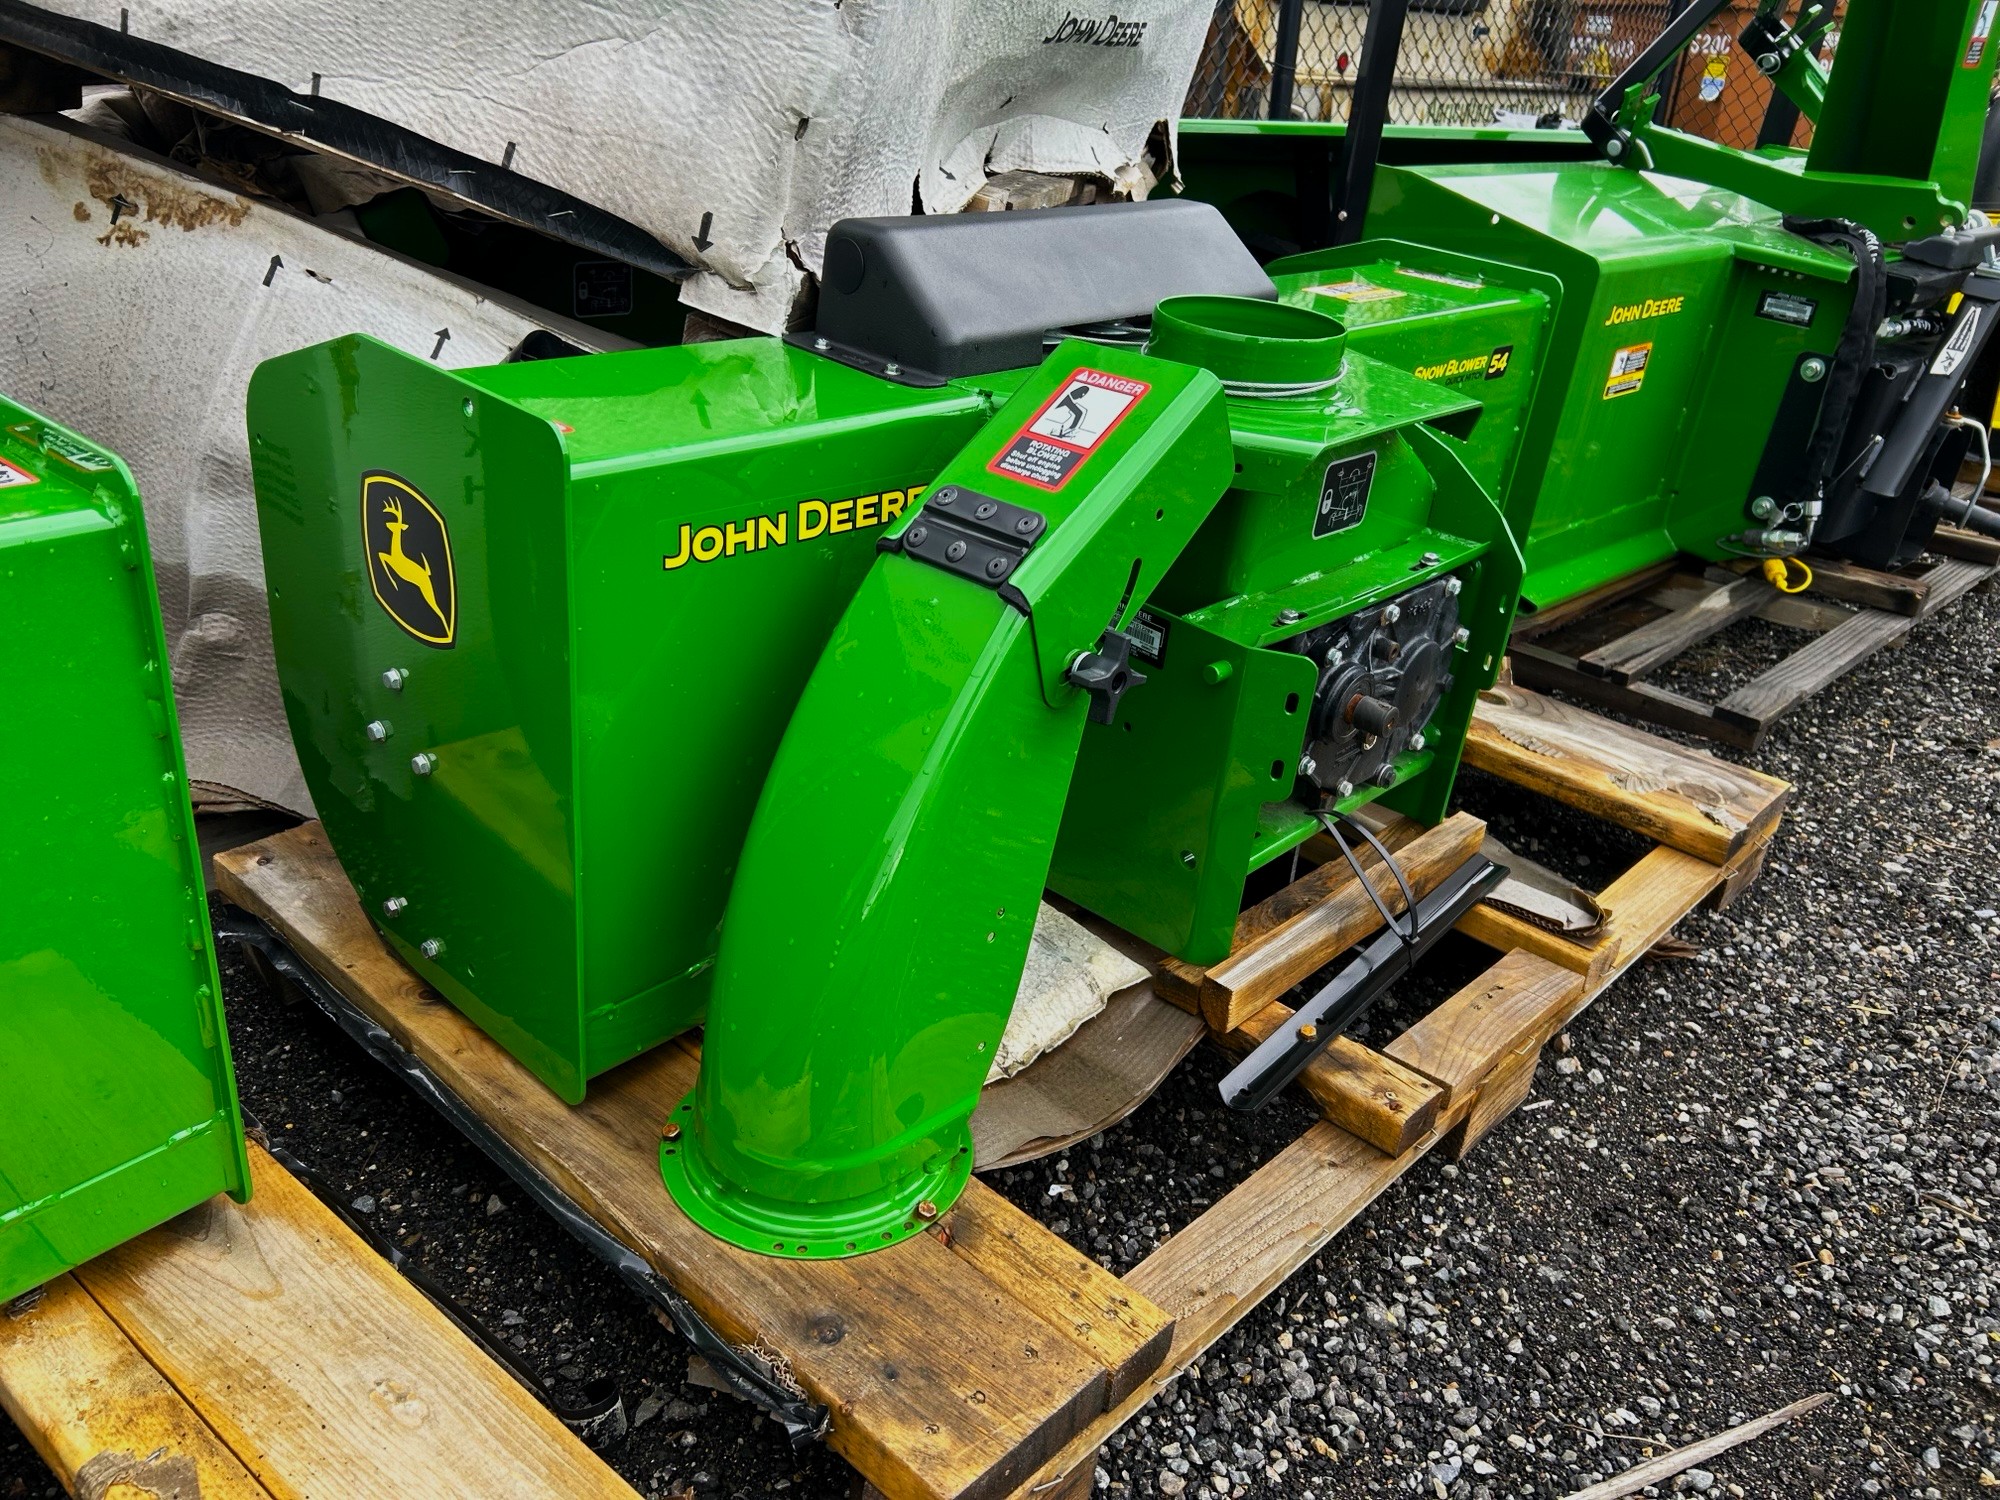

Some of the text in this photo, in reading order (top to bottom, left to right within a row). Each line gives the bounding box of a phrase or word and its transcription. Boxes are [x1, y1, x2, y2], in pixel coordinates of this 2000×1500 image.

[1042, 10, 1148, 48] JOHN DEERE
[1604, 296, 1685, 327] JOHN DEERE
[1414, 351, 1510, 381] SNOW BLOWER 54
[1087, 373, 1145, 396] DANGER
[1010, 449, 1028, 460] Shut
[1037, 459, 1061, 471] engine
[1026, 446, 1064, 463] BLOWER
[1029, 440, 1071, 458] ROTATING
[1005, 455, 1062, 480] before unclogging
[662, 511, 789, 571] JOHN
